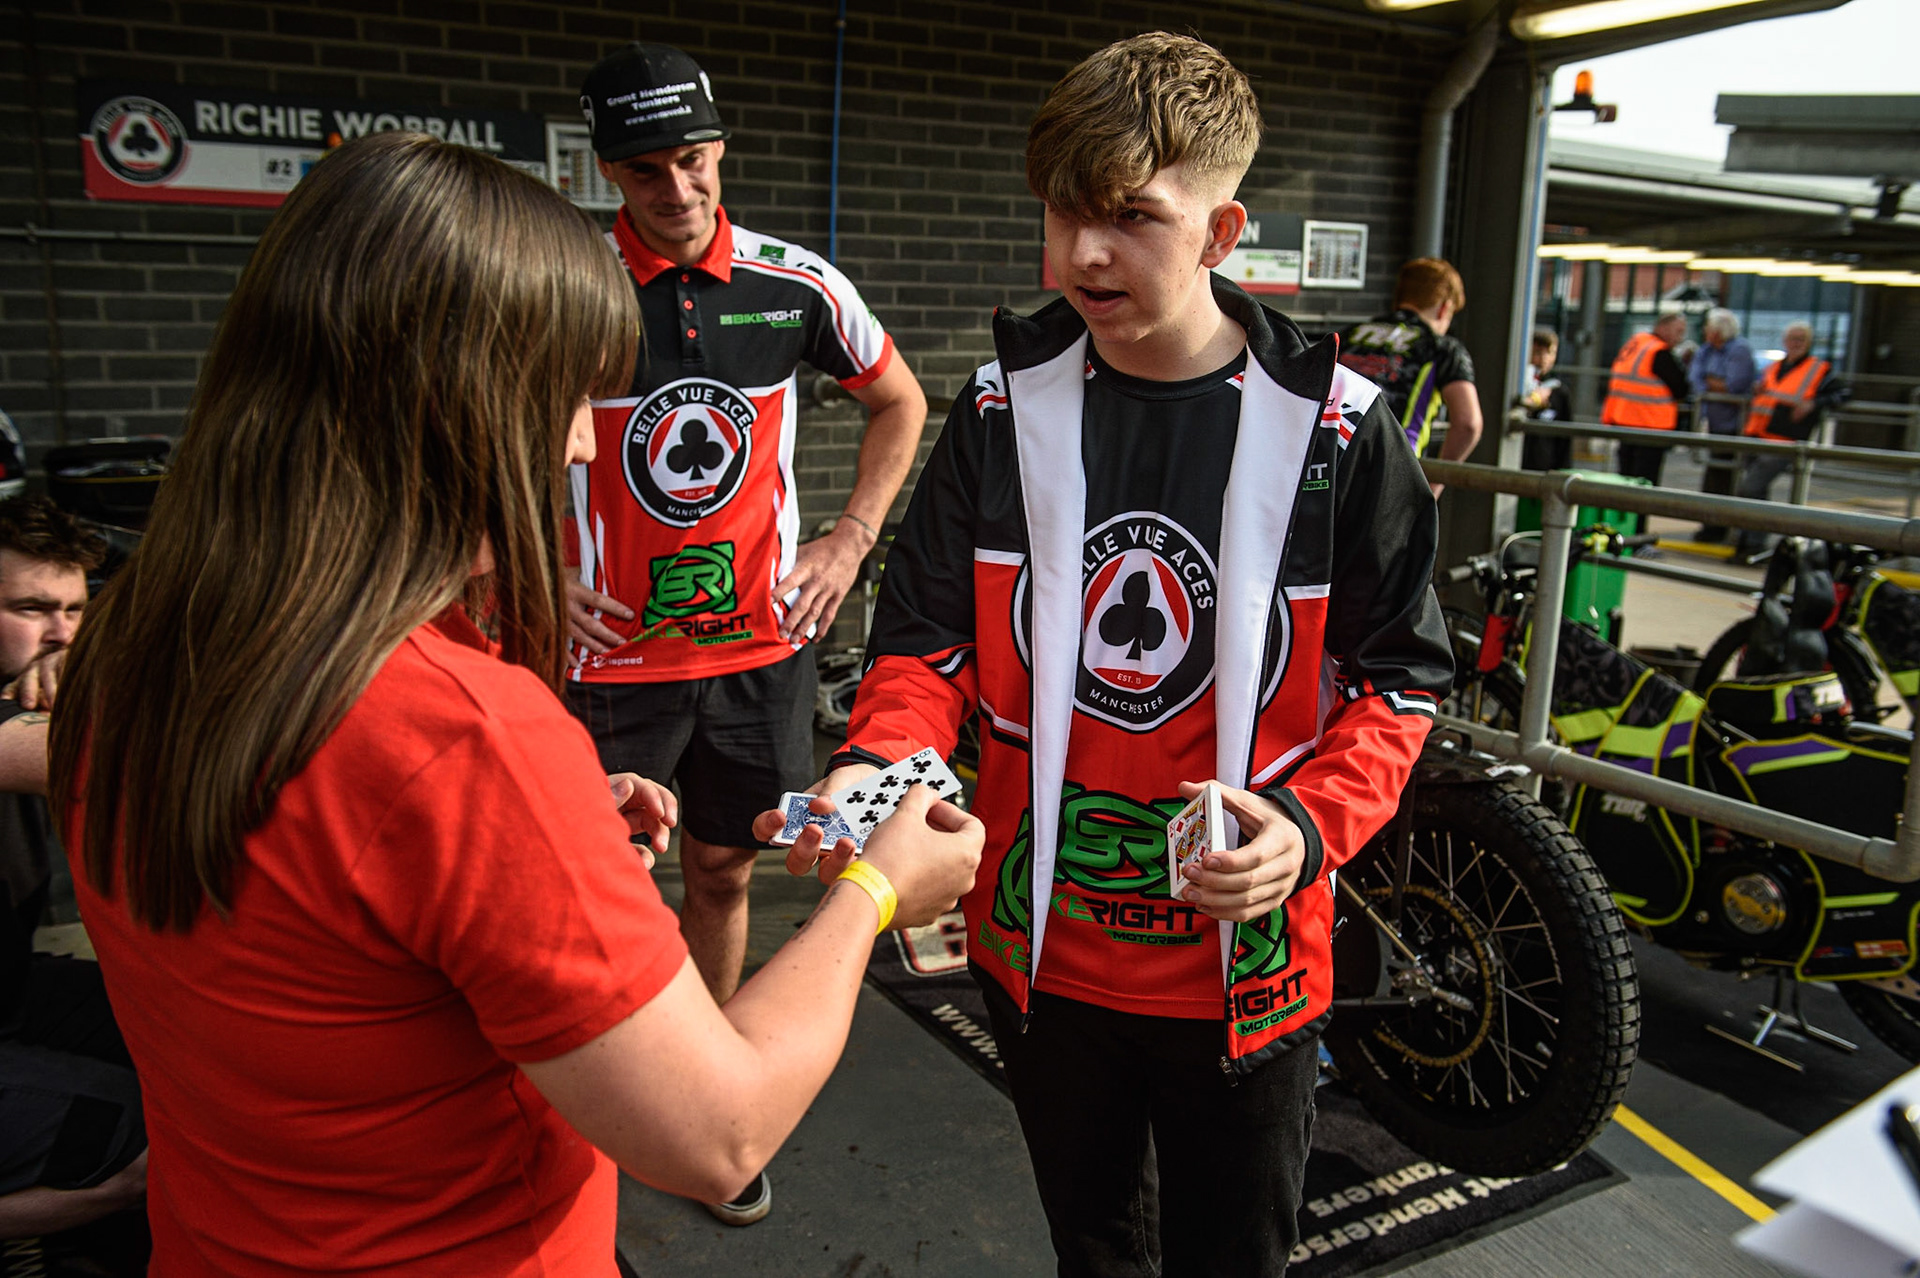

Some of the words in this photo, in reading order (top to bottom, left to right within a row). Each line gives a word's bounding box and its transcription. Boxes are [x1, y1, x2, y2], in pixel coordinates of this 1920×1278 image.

[195, 100, 323, 140] RICHIE
[266, 158, 293, 175] #2
[632, 396, 672, 444] BELLE
[677, 387, 715, 402] VUE
[1083, 533, 1119, 579] LLE
[1127, 525, 1168, 551] VUE
[1170, 549, 1214, 609] ACES
[1117, 673, 1133, 684] EST.
[1089, 688, 1164, 714] MANCHESTER
[978, 920, 1028, 973] BIKE
[1112, 931, 1201, 945] MOTORBIKE
[1230, 967, 1308, 1020] IGHT
[1240, 995, 1308, 1035] MOTORBIKE
[1286, 1187, 1468, 1266] Henderso
